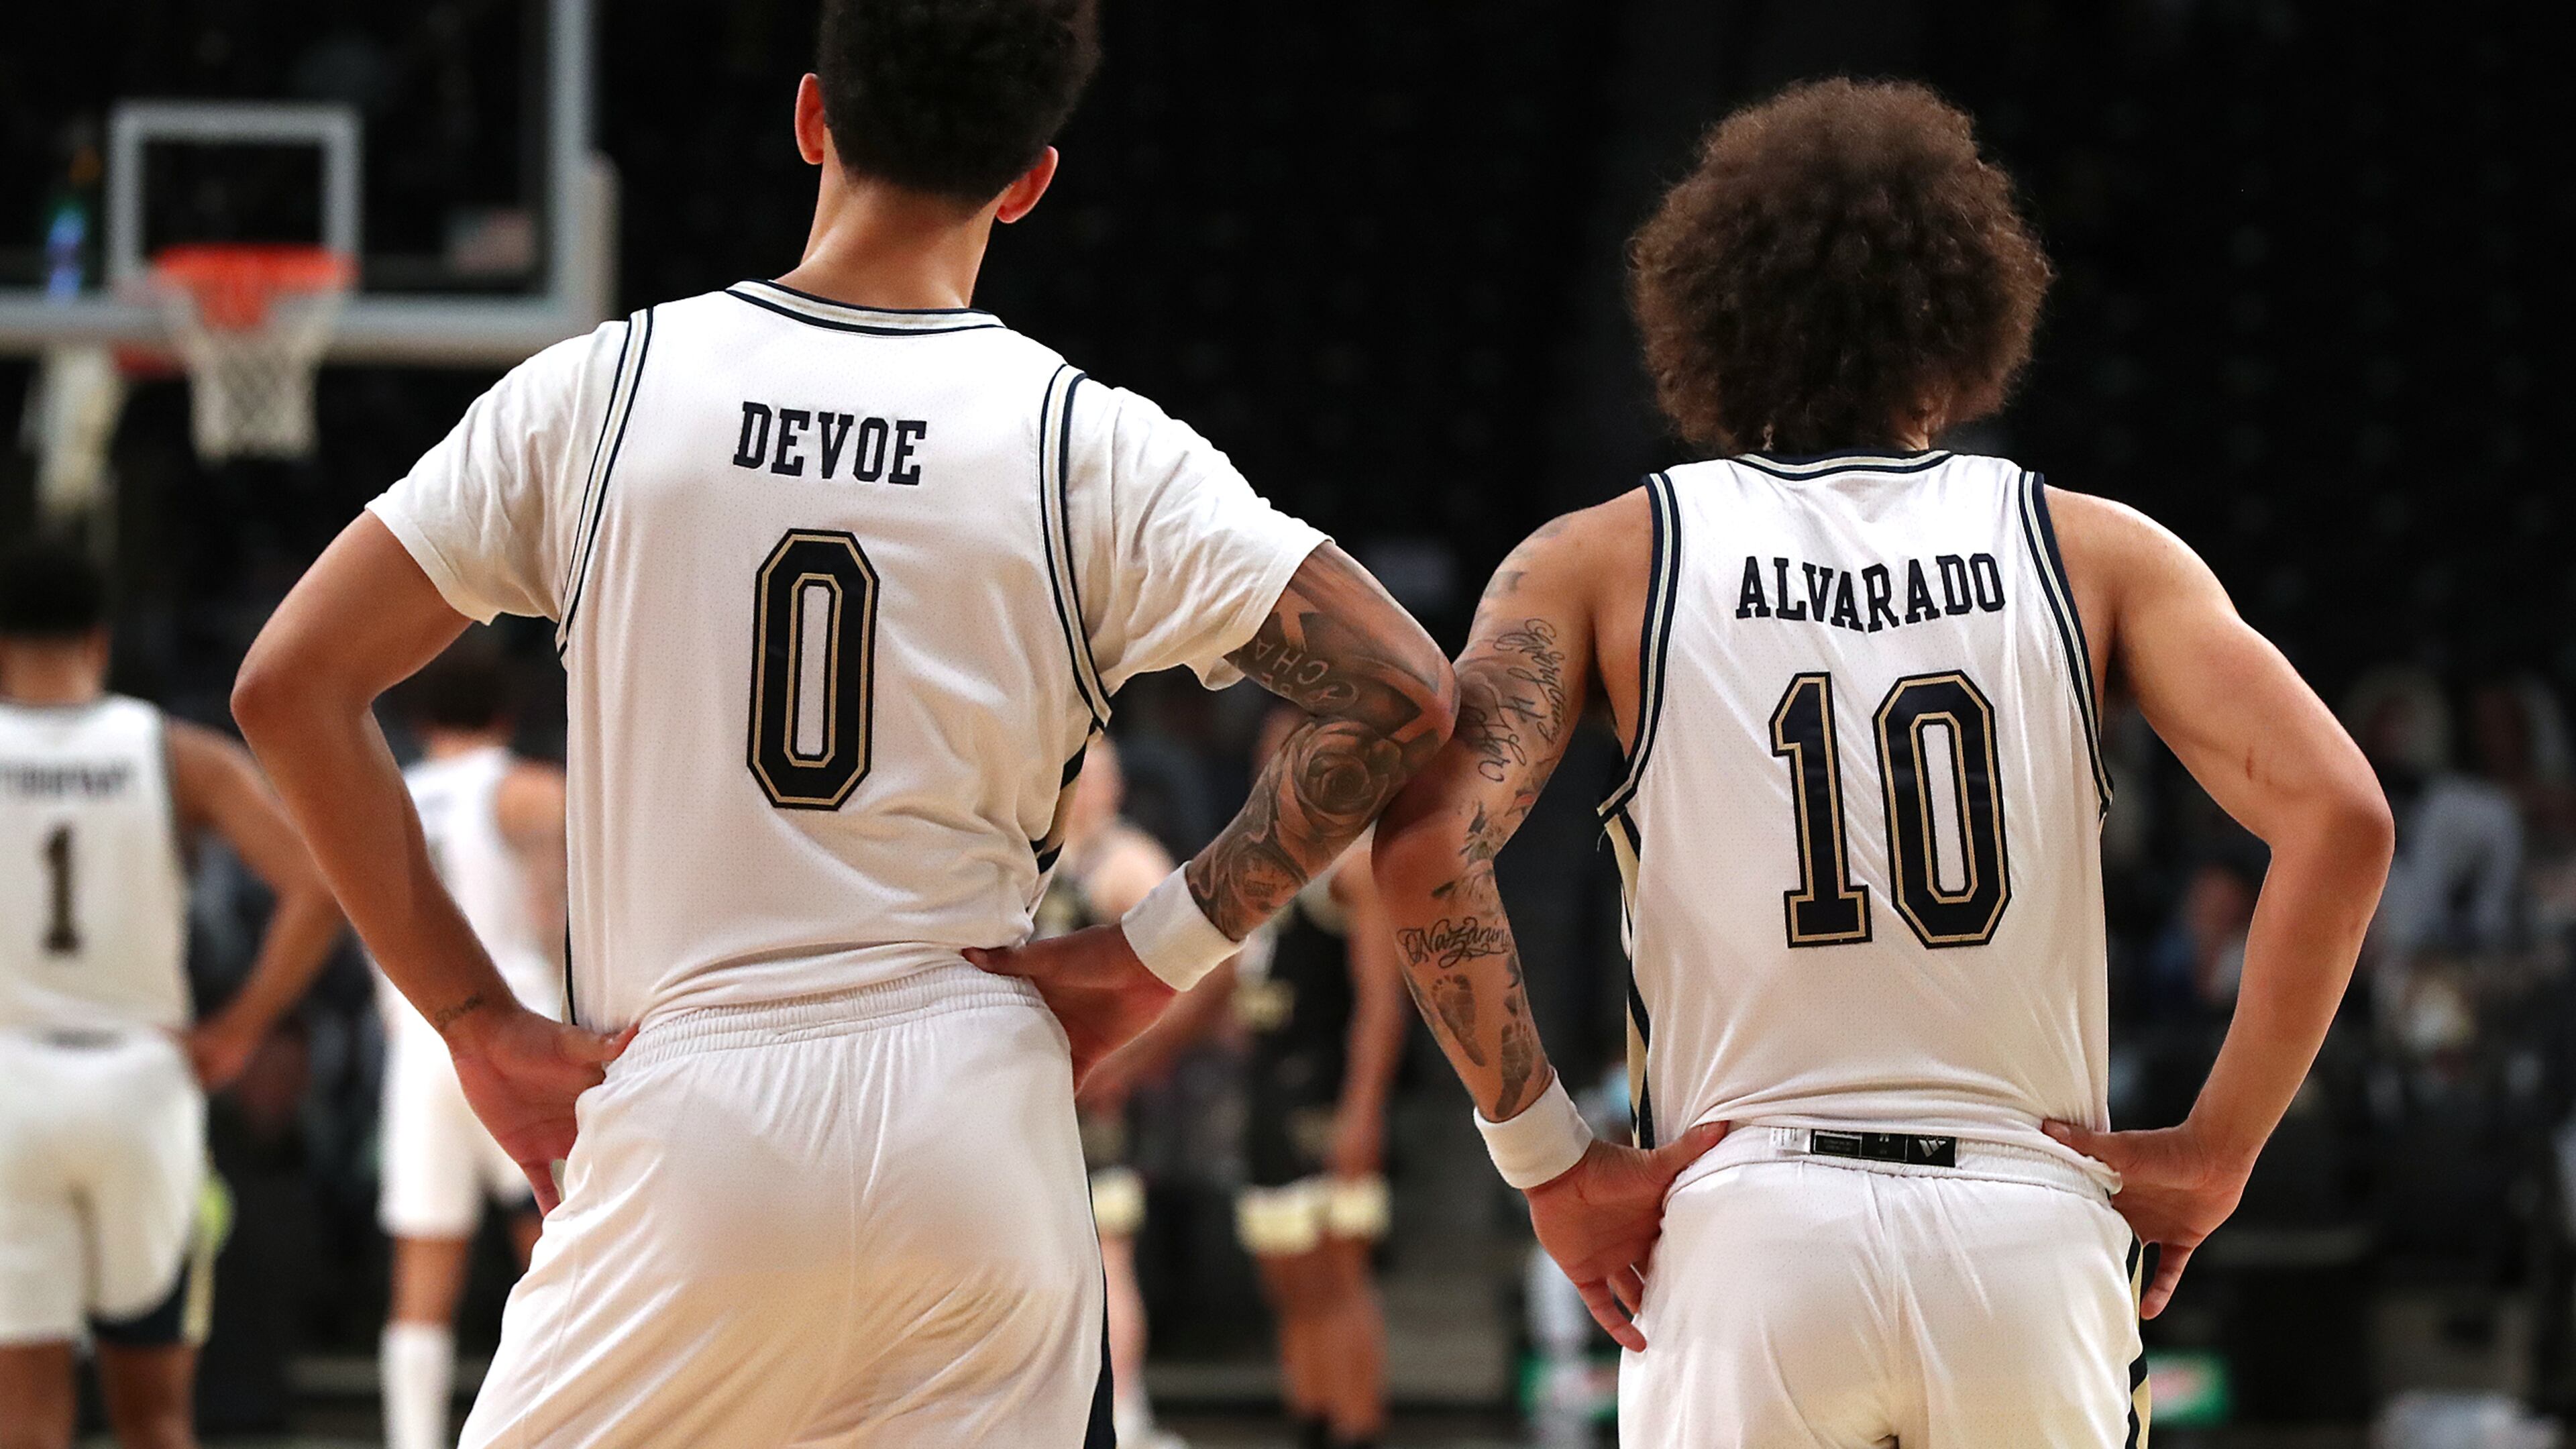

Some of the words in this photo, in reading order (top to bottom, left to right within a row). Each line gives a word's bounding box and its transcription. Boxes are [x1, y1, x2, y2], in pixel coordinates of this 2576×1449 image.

[733, 401, 927, 485] DEVOE
[1735, 553, 2006, 633] ALVARADO
[747, 528, 879, 812] 0
[1768, 669, 2012, 949] 10
[42, 822, 80, 955] 1
